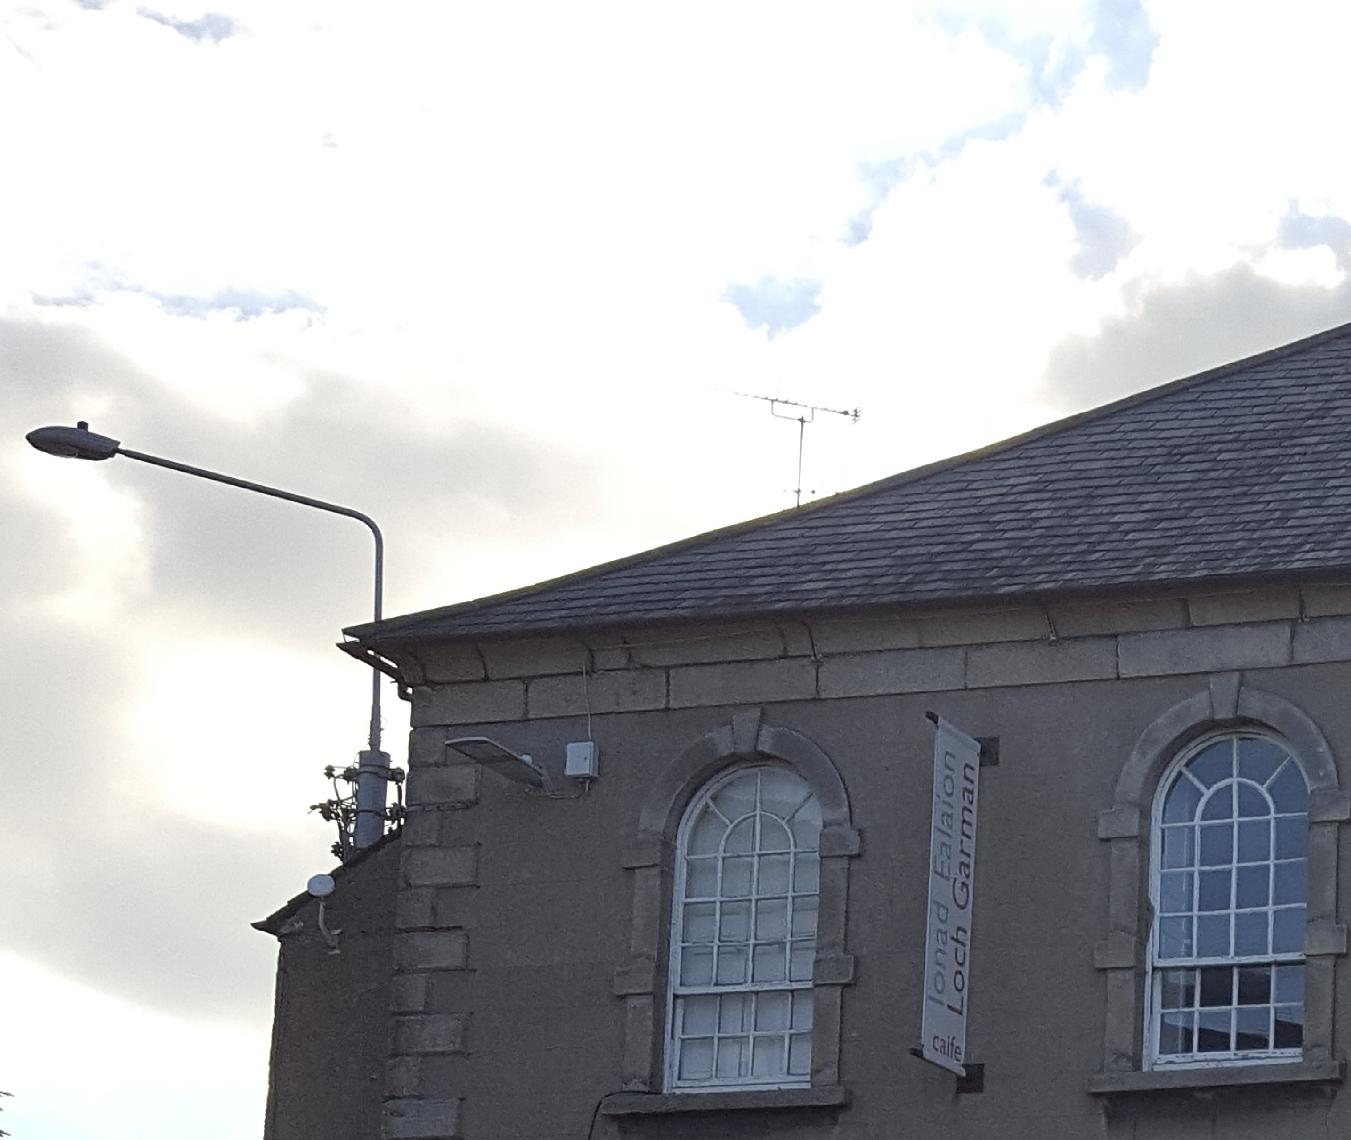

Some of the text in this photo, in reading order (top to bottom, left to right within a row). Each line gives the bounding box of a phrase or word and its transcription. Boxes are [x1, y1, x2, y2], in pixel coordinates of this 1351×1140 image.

[927, 901, 950, 1006] Ionad
[946, 763, 976, 1017] Loch Garman
